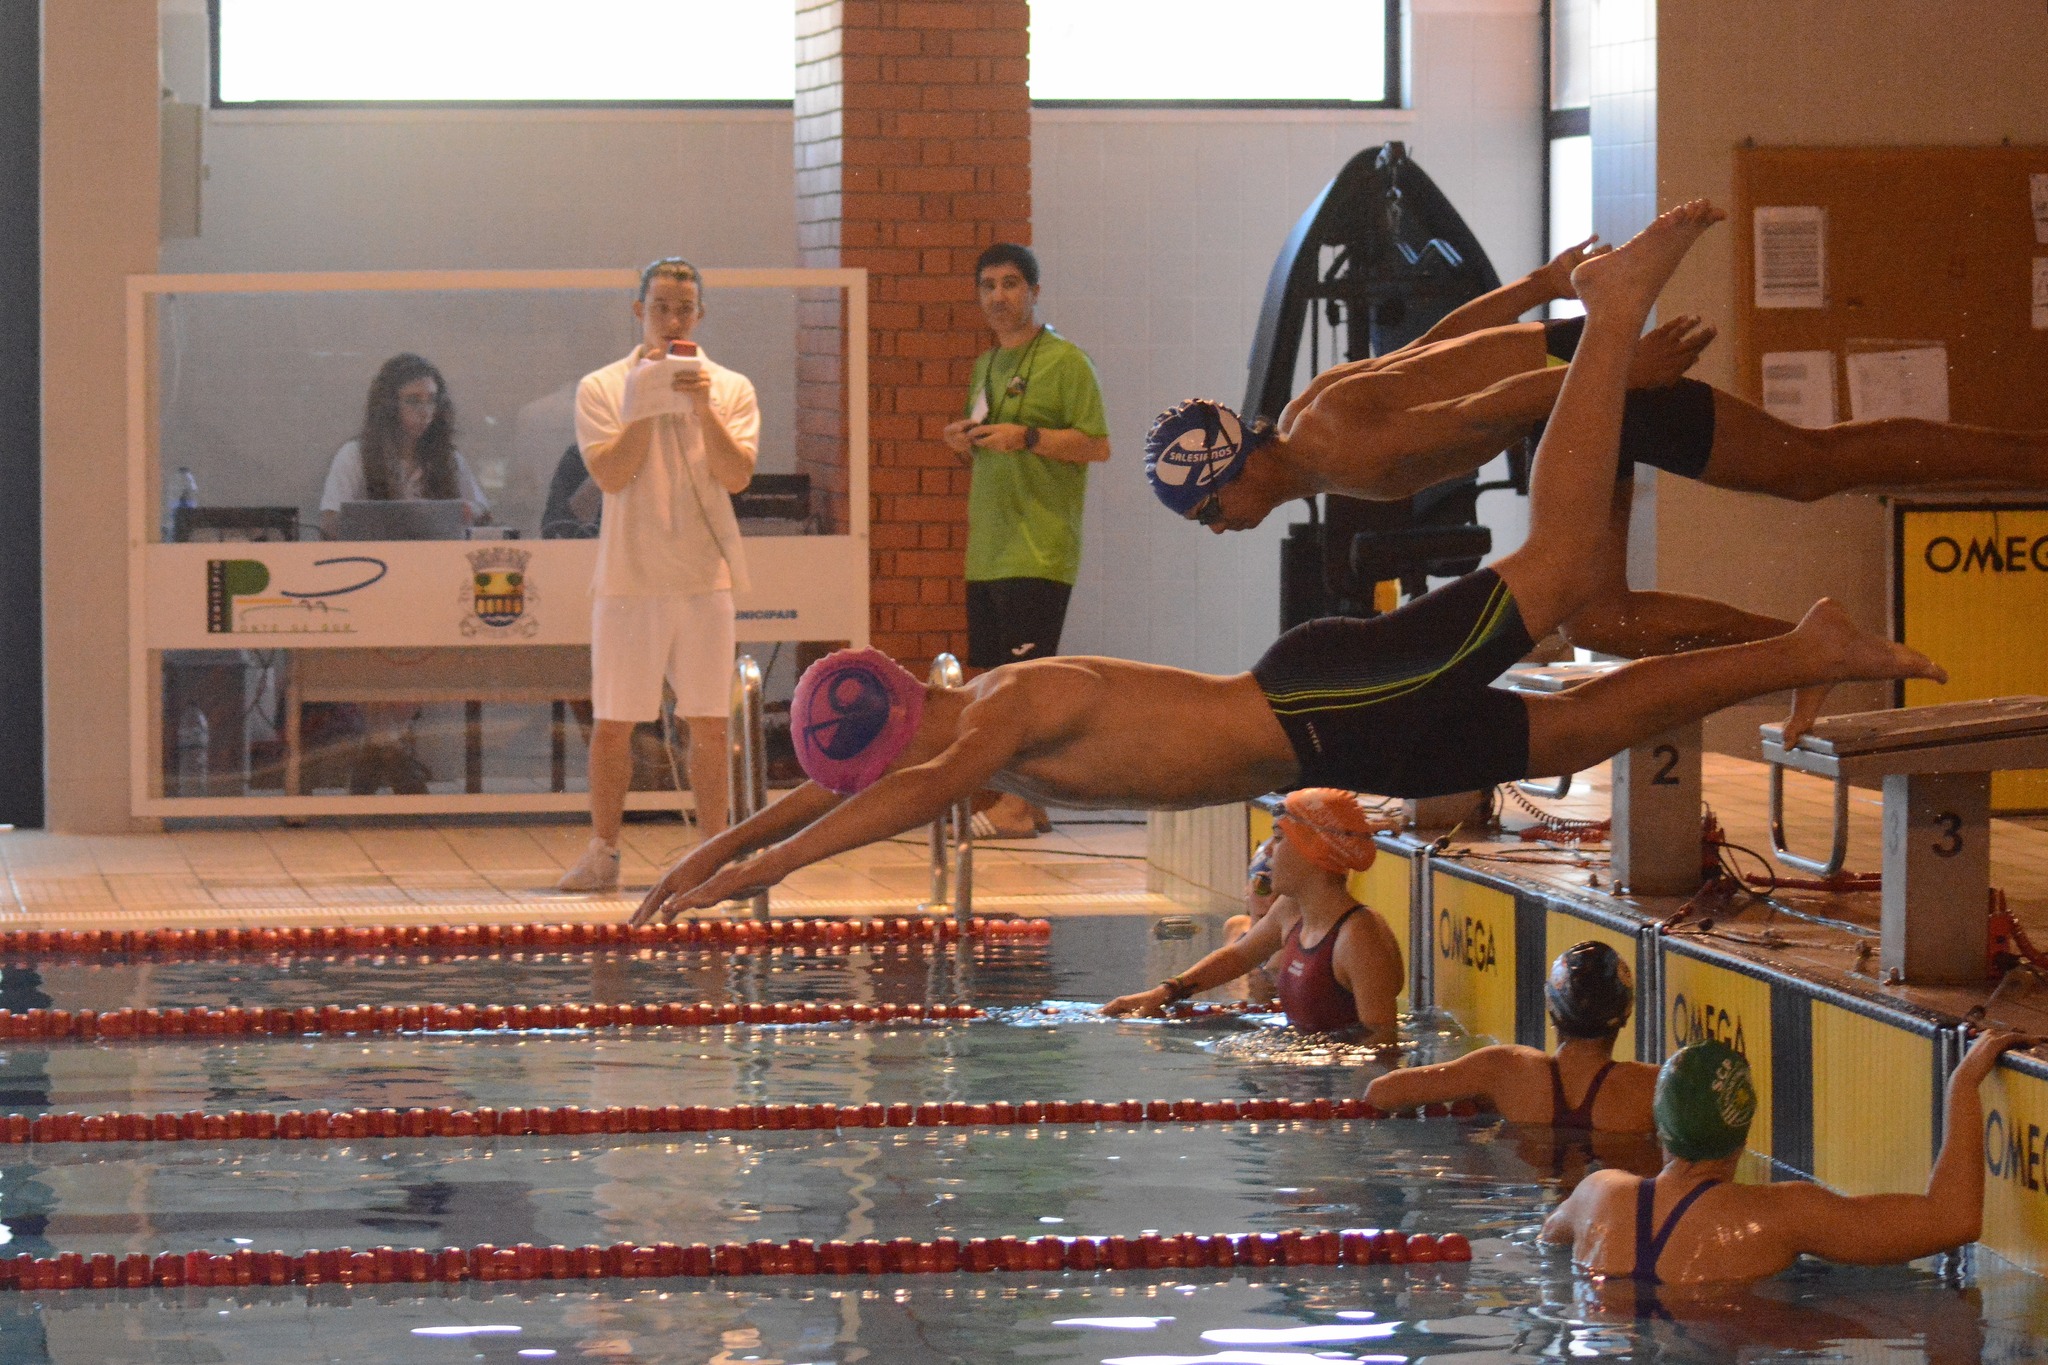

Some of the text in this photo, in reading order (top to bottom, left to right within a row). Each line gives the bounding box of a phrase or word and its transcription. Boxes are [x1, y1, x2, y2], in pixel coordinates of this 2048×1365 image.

[1652, 744, 1680, 785] 2
[1931, 811, 1964, 858] 3
[1439, 908, 1496, 974] OMEGA
